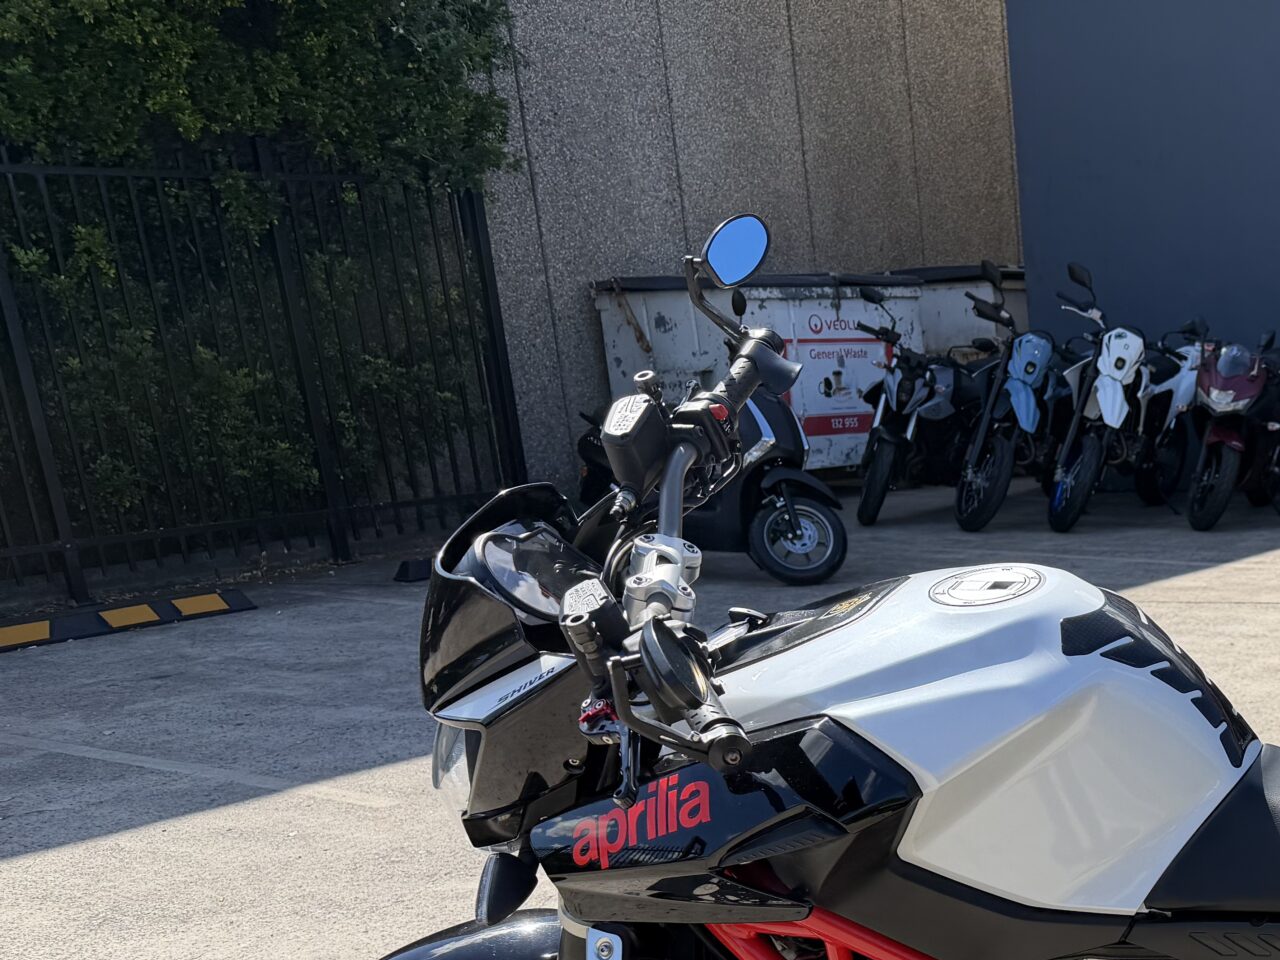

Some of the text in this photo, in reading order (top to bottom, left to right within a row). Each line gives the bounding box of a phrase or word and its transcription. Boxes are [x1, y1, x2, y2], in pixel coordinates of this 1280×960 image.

[810, 348, 868, 360] General Waste
[497, 666, 556, 703] SHIVER
[572, 774, 711, 870] aprilia
